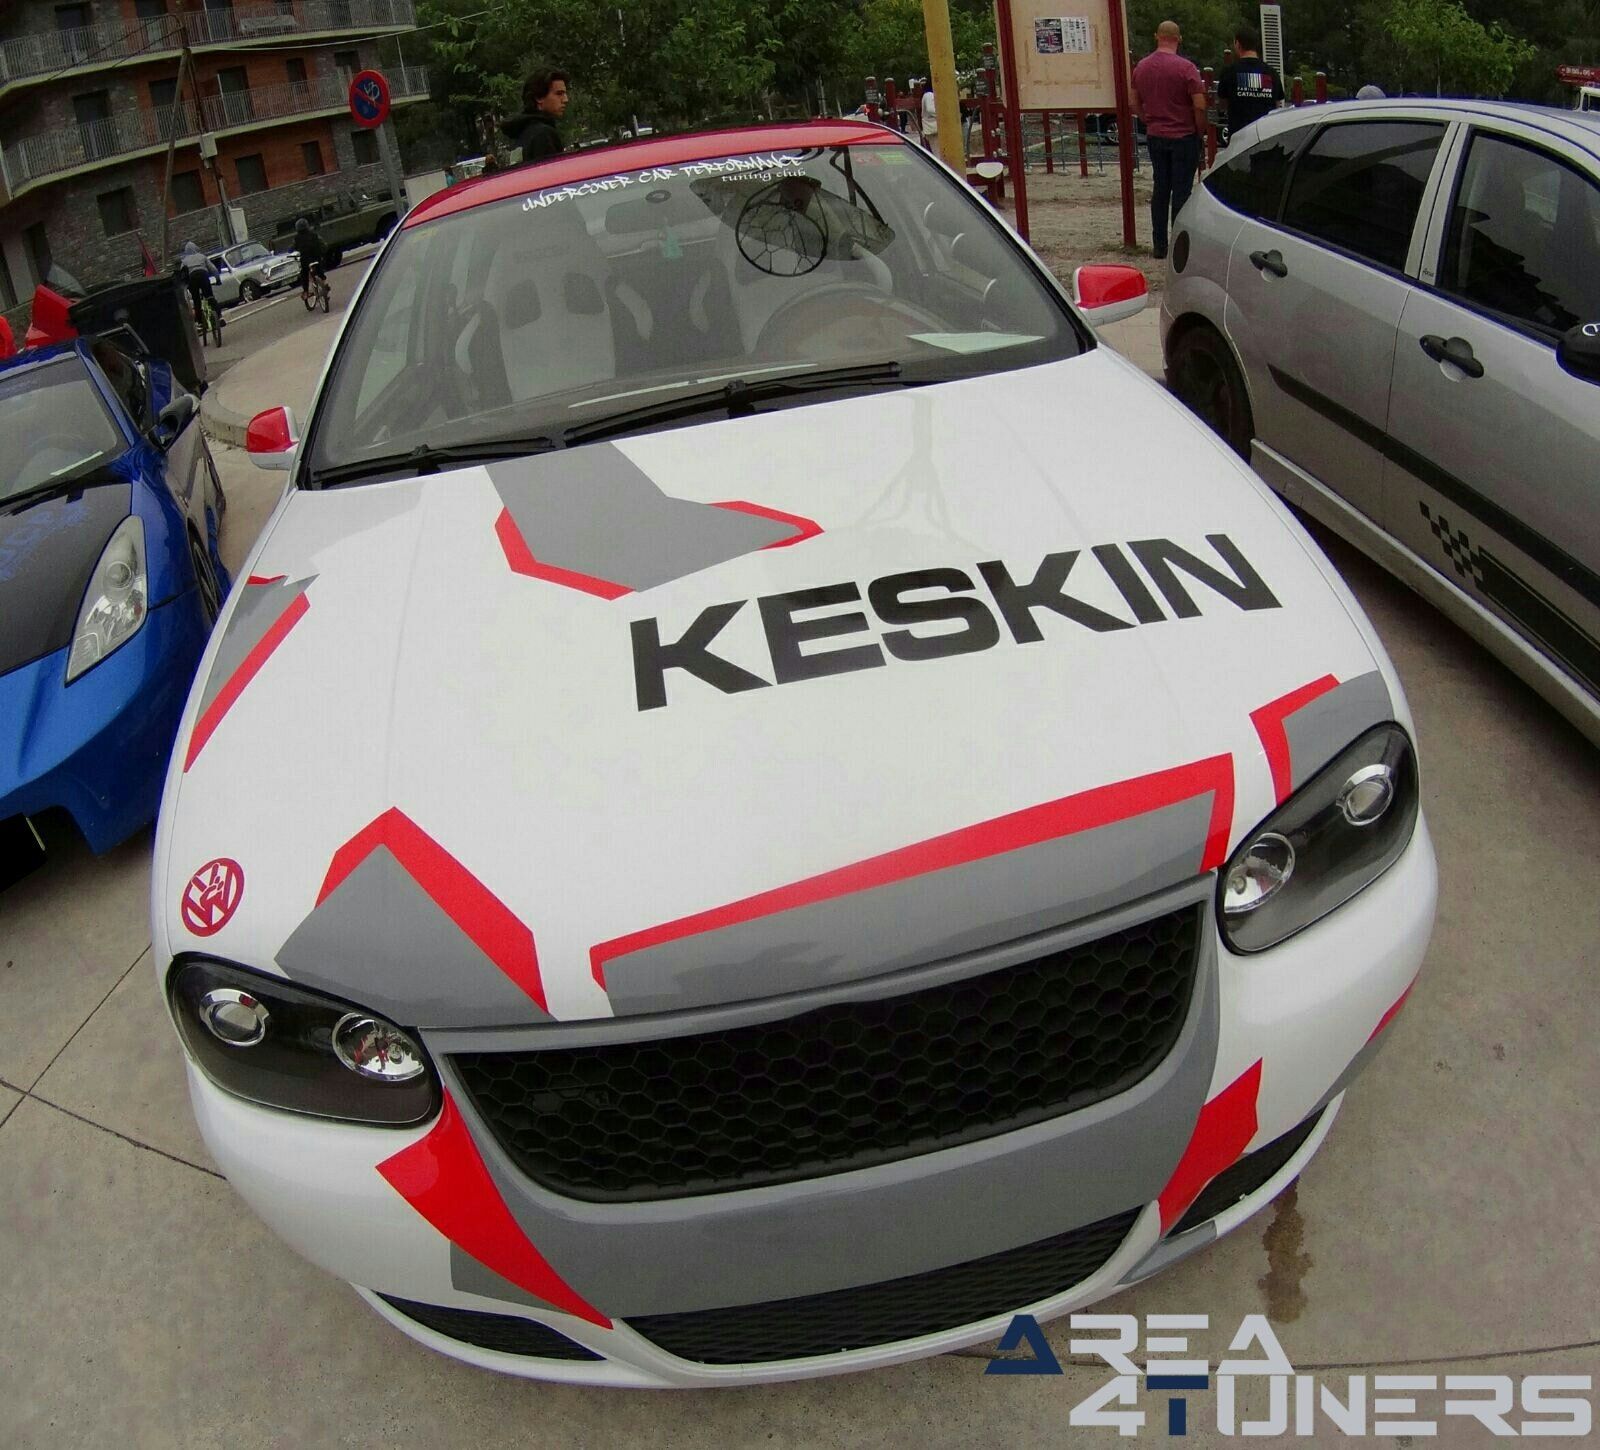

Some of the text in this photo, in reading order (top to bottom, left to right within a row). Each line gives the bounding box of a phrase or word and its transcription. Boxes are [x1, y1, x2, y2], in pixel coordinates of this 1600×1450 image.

[1237, 91, 1273, 99] CATALUNYA
[522, 152, 805, 211] UNDERCOVER CAR PERFORMANCE
[721, 168, 806, 182] tuning club
[629, 533, 1283, 712] KESKIN
